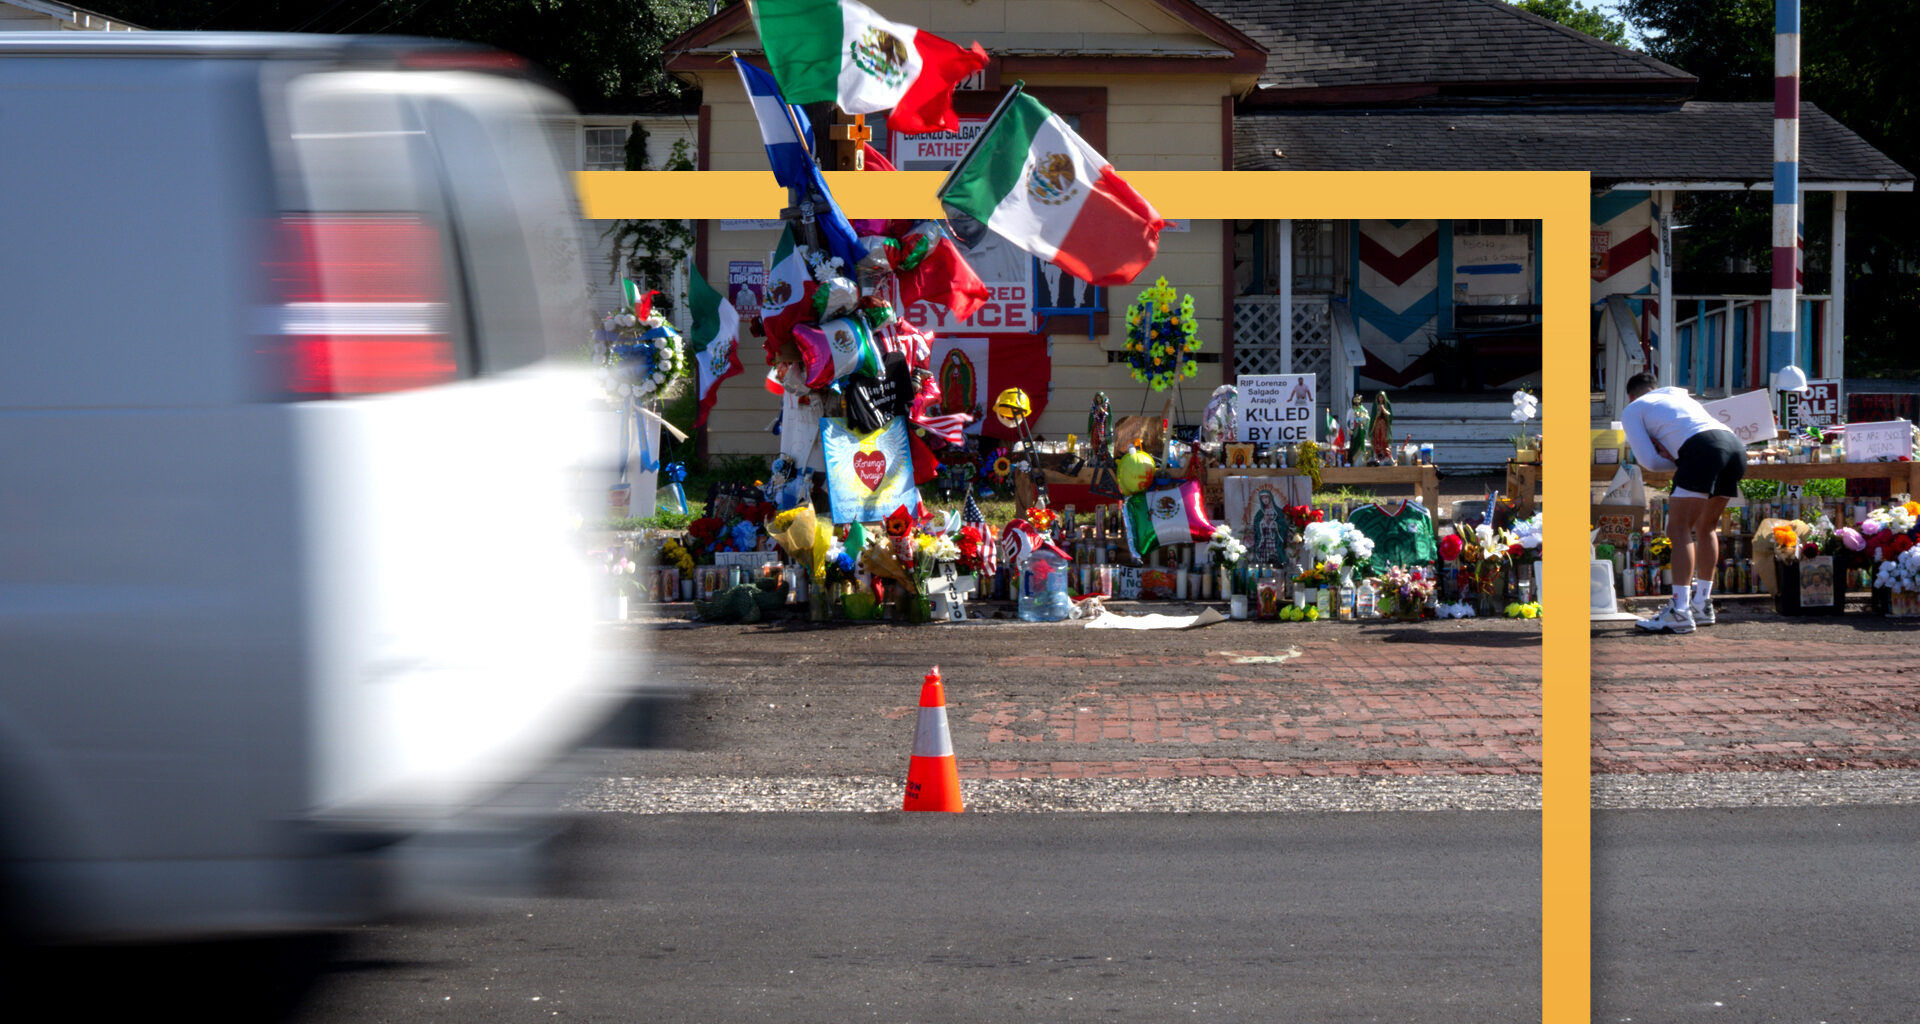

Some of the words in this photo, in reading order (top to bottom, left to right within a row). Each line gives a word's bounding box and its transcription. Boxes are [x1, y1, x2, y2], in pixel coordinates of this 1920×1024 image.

[904, 303, 950, 327] BY
[1240, 379, 1254, 387] RIP
[1256, 379, 1287, 387] Lorenzo
[1248, 388, 1280, 397] Salgado
[1801, 386, 1829, 400] OR
[1251, 397, 1277, 405] Araujo
[1801, 400, 1837, 414] ALE
[1249, 427, 1273, 441] BY
[1278, 426, 1307, 440] ICE
[1735, 422, 1759, 440] ngs
[945, 564, 968, 619] ARAUJO
